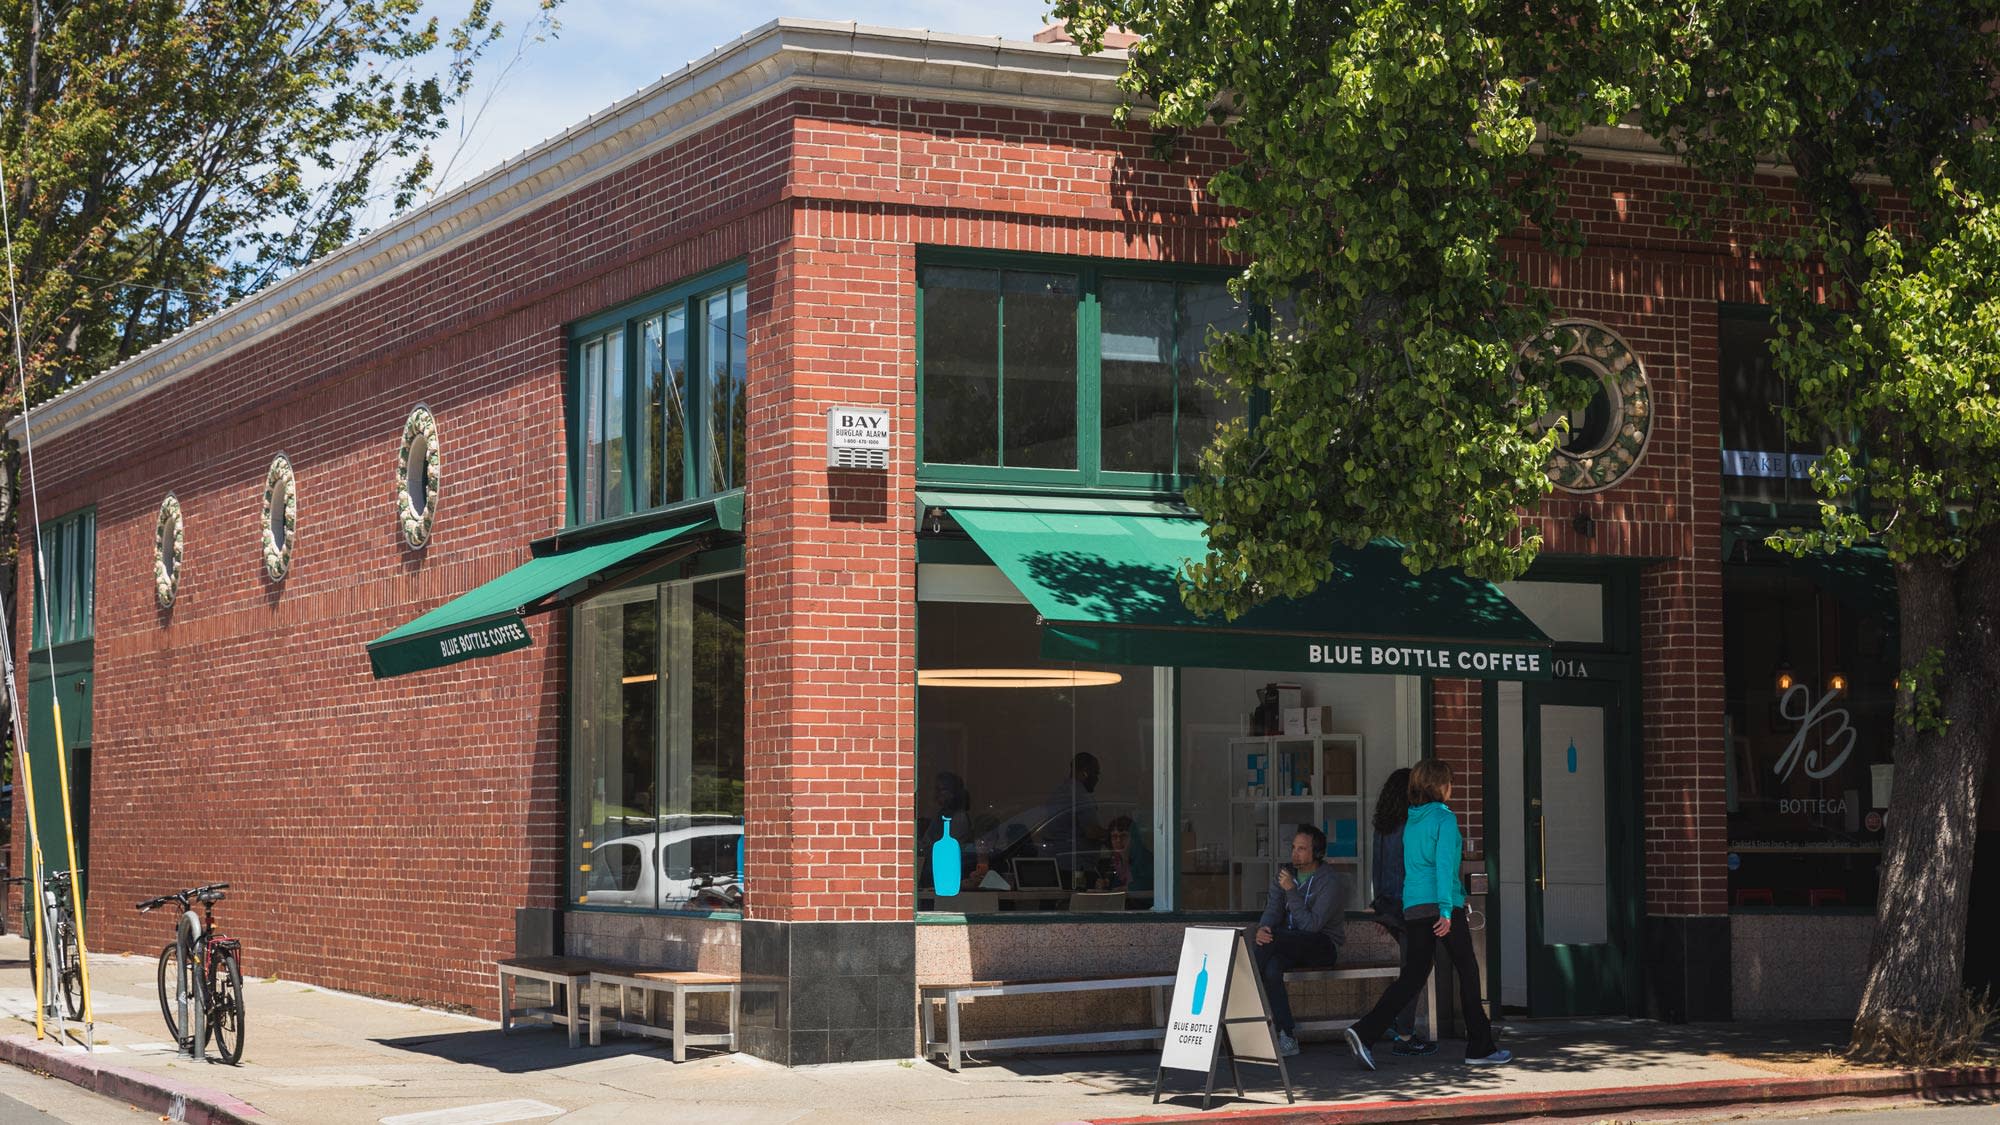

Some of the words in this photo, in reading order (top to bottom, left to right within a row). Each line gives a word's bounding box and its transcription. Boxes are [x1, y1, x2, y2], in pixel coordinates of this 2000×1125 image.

[842, 415, 882, 428] BAY
[836, 429, 864, 437] BURGLAR
[866, 430, 887, 438] ALARM
[1740, 456, 1782, 472] TAKE
[440, 638, 460, 657] BLUE
[459, 632, 490, 652] BOTTLE
[489, 623, 524, 646] COFFEE
[1309, 645, 1362, 664] BLUE
[1371, 647, 1450, 668] BOTTLE
[1458, 651, 1539, 672] COFFEE
[1551, 659, 1589, 678] 01A
[1780, 799, 1847, 815] BOTTEGA
[1173, 1021, 1189, 1032] BLUE
[1190, 1023, 1213, 1033] BOTTLE
[1178, 1034, 1203, 1045] COFFEE
